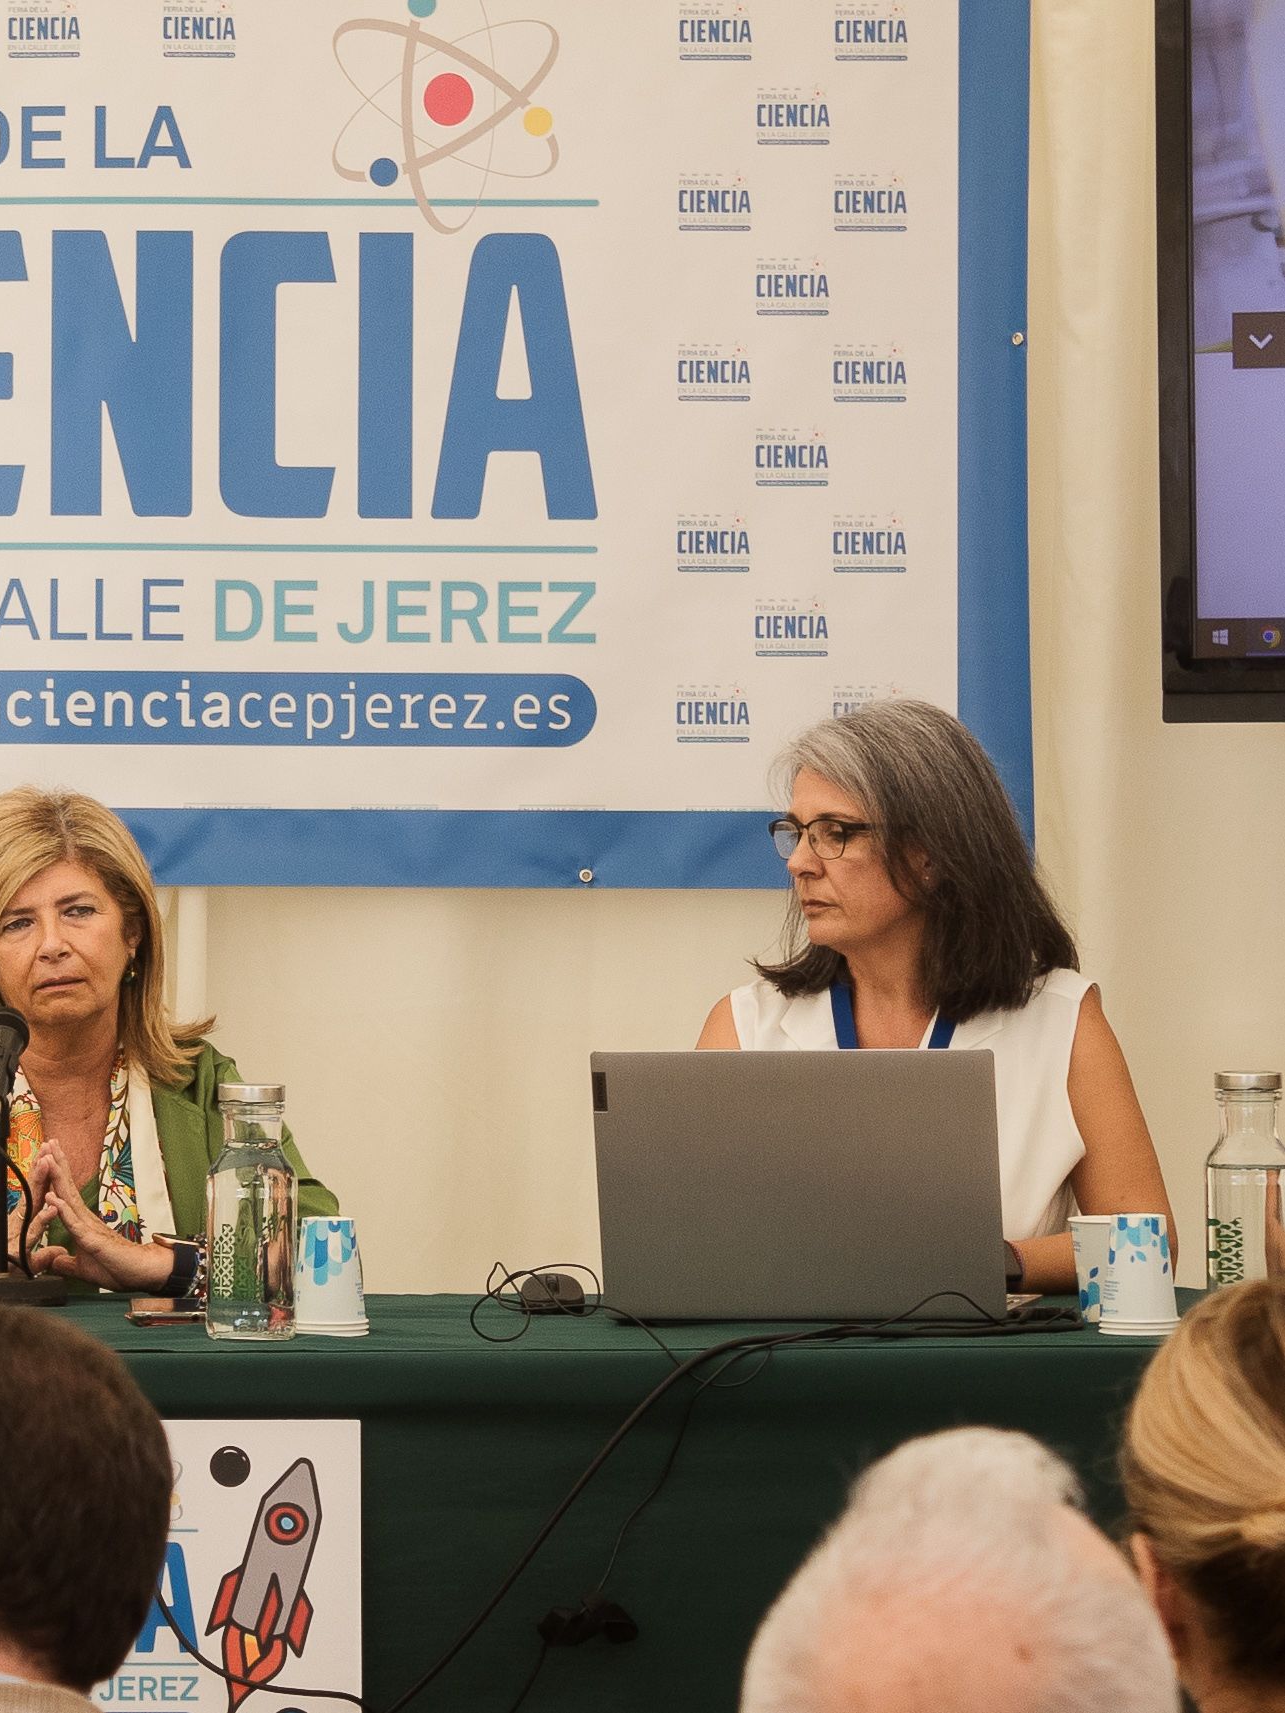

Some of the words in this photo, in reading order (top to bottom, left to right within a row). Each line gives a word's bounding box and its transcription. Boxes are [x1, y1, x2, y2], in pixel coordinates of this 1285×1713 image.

[8, 16, 81, 40] CIENCIA
[163, 16, 236, 40] CIENCIA
[679, 19, 752, 43] CIENCIA
[834, 19, 907, 43] CIENCIA
[756, 104, 829, 128] CIENCIA
[95, 106, 191, 168] LA
[678, 189, 751, 213] CIENCIA
[834, 190, 907, 214] CIENCIA
[756, 274, 829, 298] CIENCIA
[677, 360, 750, 384] CIENCIA
[833, 360, 906, 384] CIENCIA
[755, 444, 828, 468] CIENCIA
[677, 530, 750, 554] CIENCIA
[833, 531, 906, 555] CIENCIA
[215, 580, 317, 642] DE
[337, 581, 596, 643] JEREZ
[755, 615, 828, 639] CIENCIA
[676, 701, 749, 725] CIENCIA
[99, 1676, 200, 1701] JEREZ
